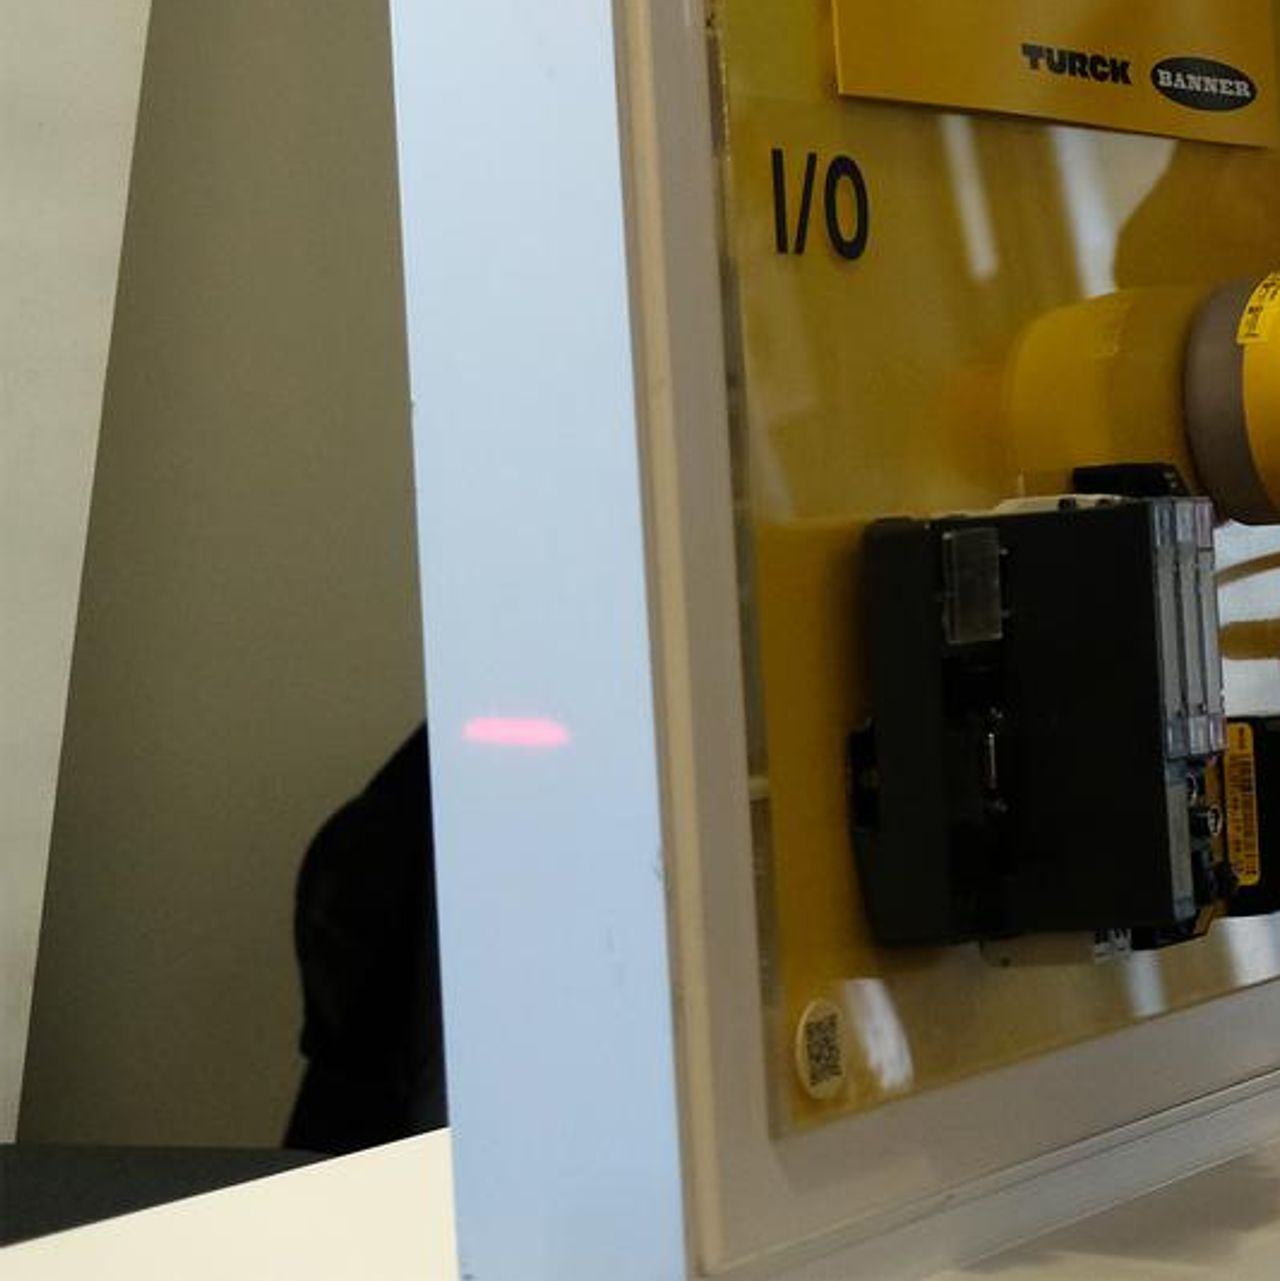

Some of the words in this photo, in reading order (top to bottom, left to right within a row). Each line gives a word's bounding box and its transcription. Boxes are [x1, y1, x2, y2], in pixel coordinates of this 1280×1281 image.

[1021, 42, 1132, 85] TURCK
[1156, 68, 1252, 98] BANNER
[771, 148, 869, 260] I/O
